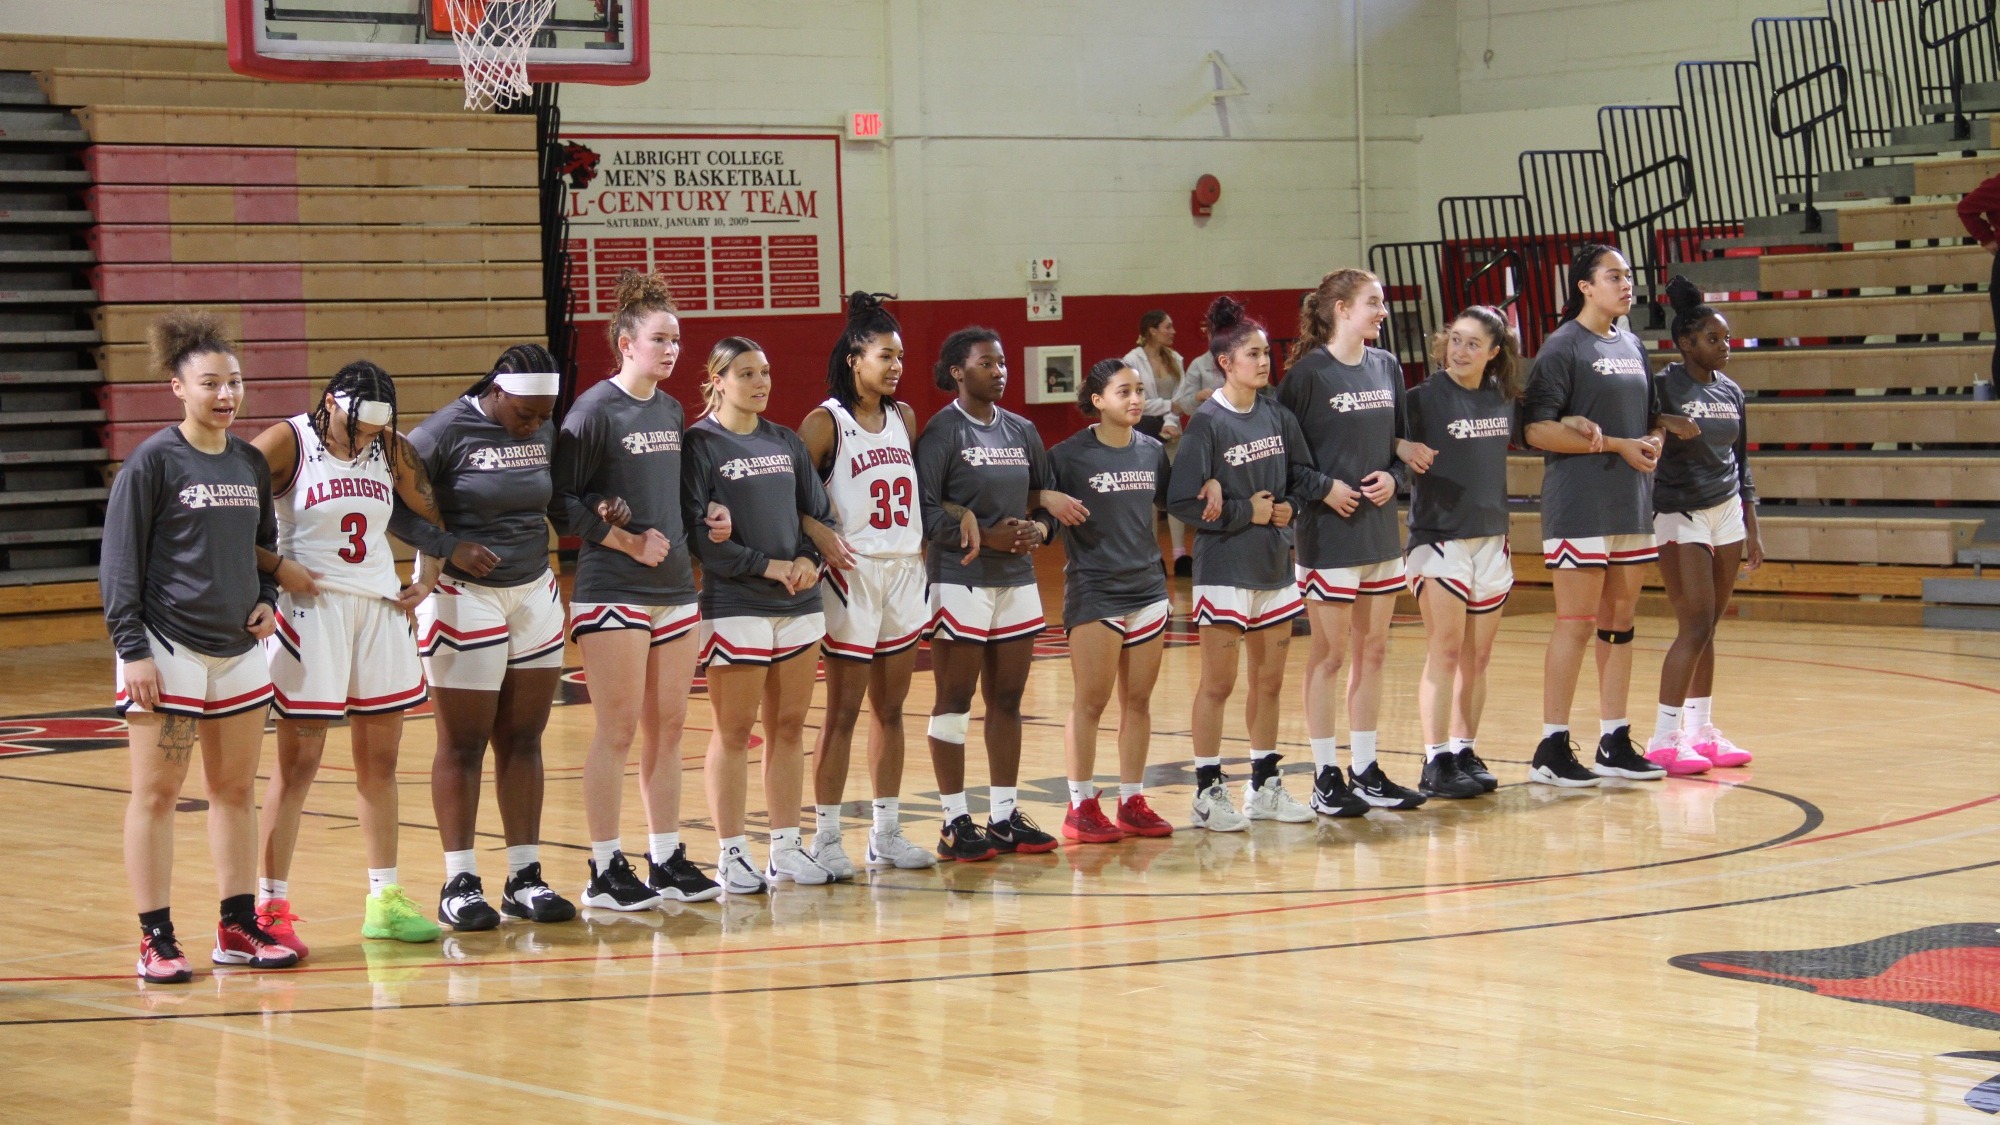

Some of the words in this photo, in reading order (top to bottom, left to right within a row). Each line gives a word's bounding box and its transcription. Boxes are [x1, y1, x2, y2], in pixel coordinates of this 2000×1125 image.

[855, 113, 879, 136] EXIT
[613, 150, 701, 166] ALBRIGHT
[707, 150, 784, 166] COLLEGE
[604, 169, 666, 187] MEN'S
[674, 169, 801, 187] BASKETBALL
[561, 190, 731, 218] L-CENTURY
[741, 190, 818, 219] TEAM
[606, 218, 662, 228] SATURDAY,
[665, 217, 710, 229] JANUARY
[714, 217, 726, 227] 10,
[729, 217, 749, 227] 2009
[1602, 358, 1643, 376] ALBRIGH
[1691, 400, 1738, 418] ALBRIGH
[480, 444, 547, 470] ALBRIGHT
[731, 454, 792, 480] ALBRIGHT
[971, 446, 1025, 466] ALBRIGH
[1098, 470, 1155, 493] ALBRIGHT
[190, 483, 259, 509] ALBRIGHT
[219, 497, 261, 509] BASKETBA
[304, 477, 391, 511] ALBRIGHT
[869, 476, 913, 530] 33
[337, 512, 368, 564] 3
